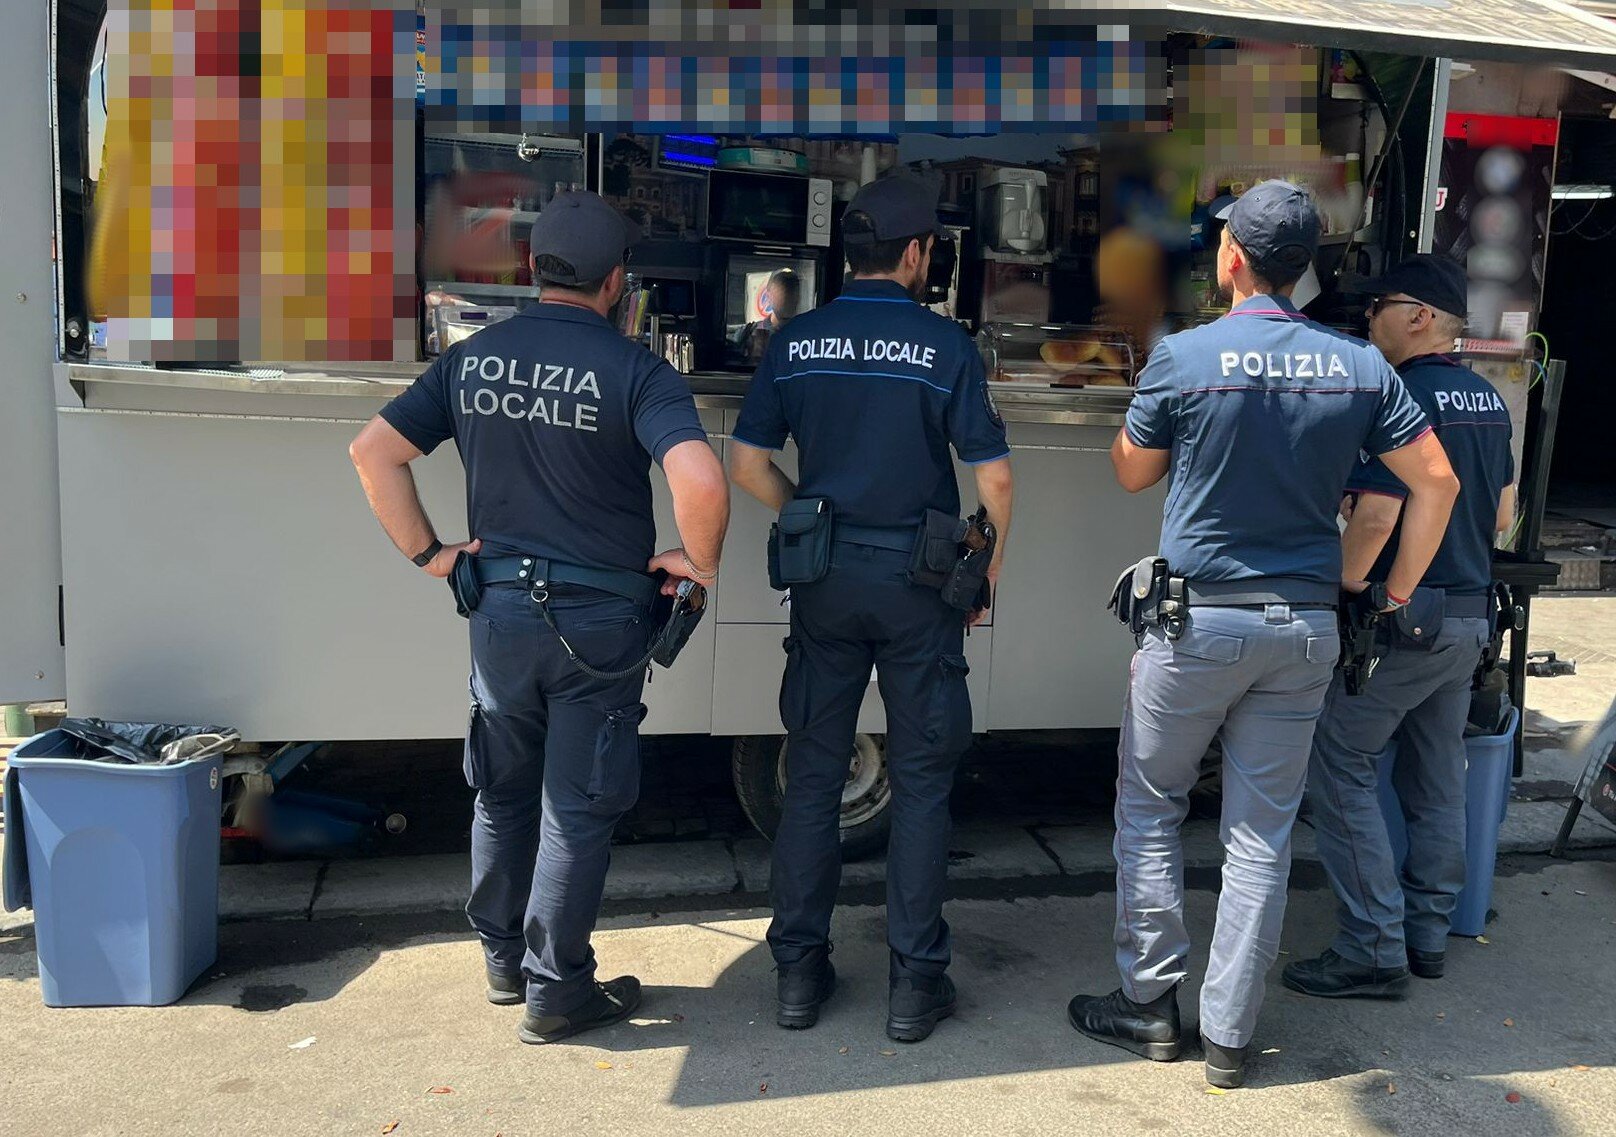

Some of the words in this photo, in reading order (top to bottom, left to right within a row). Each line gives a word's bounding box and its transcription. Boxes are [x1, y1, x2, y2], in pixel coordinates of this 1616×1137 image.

[788, 337, 856, 362] POLIZIA
[863, 339, 937, 369] LOCALE
[1220, 351, 1349, 379] POLIZIA
[460, 355, 601, 399] POLIZIA
[459, 388, 599, 432] LOCALE
[1434, 390, 1505, 412] POLIZIA
